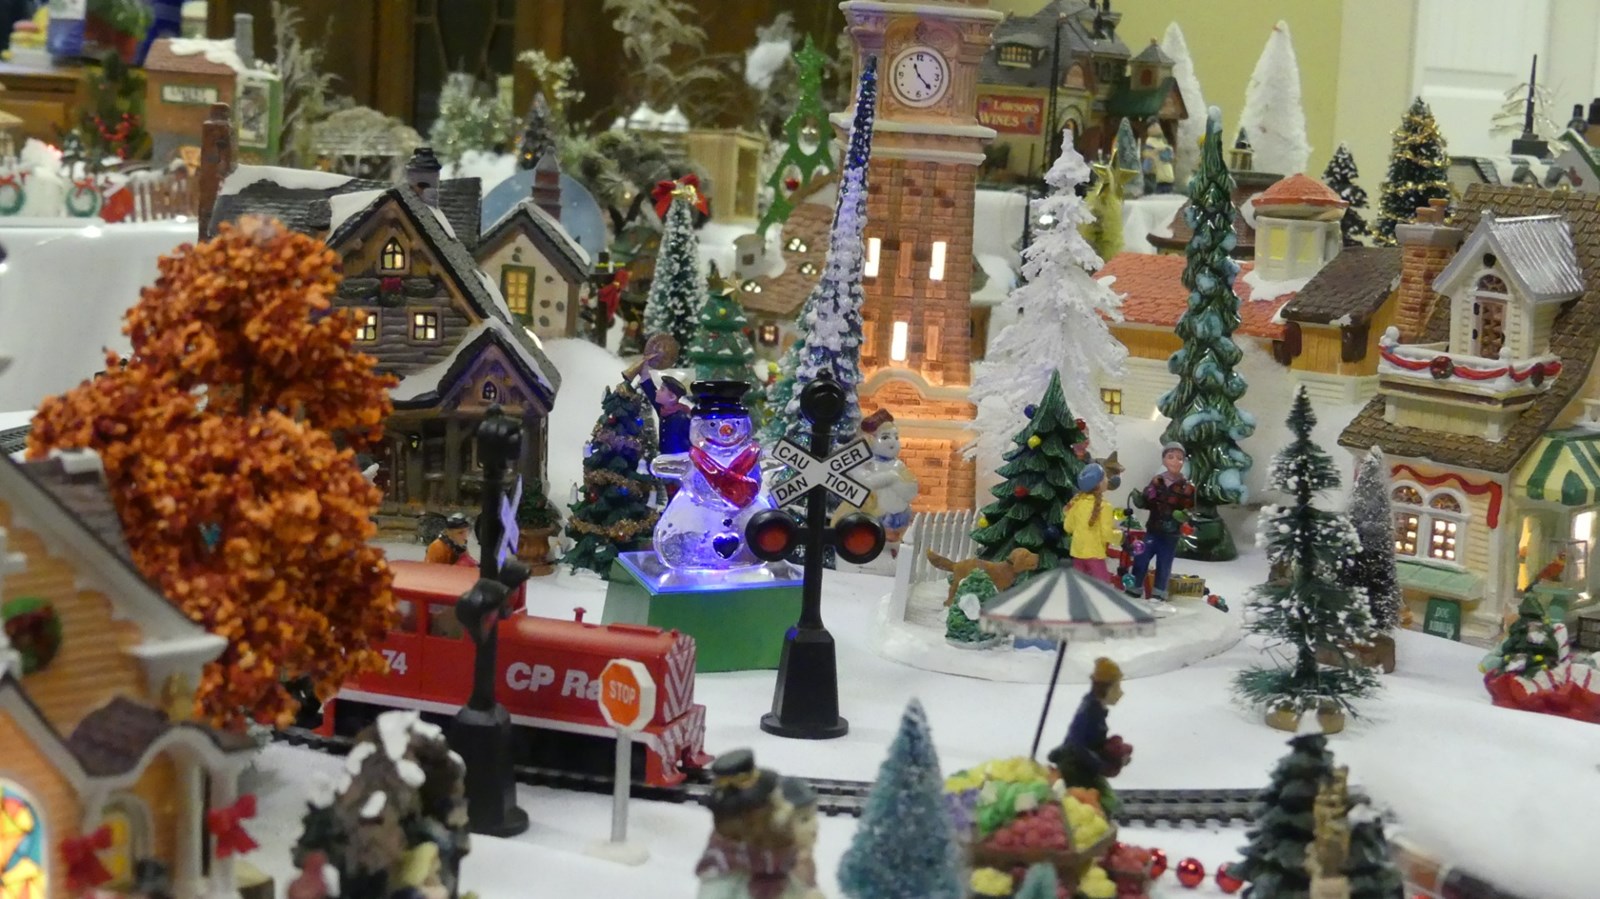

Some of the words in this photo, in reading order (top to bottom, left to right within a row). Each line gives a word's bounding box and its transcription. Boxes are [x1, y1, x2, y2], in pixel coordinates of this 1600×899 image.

[916, 53, 924, 62] 12
[898, 71, 904, 80] 9
[934, 73, 940, 82] 3
[915, 90, 922, 98] 6
[978, 111, 1019, 127] WINES
[775, 476, 809, 501] DAN
[830, 448, 863, 472] GER
[778, 446, 810, 470] CAU
[824, 472, 859, 500] TION
[505, 661, 555, 692] CP
[609, 680, 636, 705] STOP
